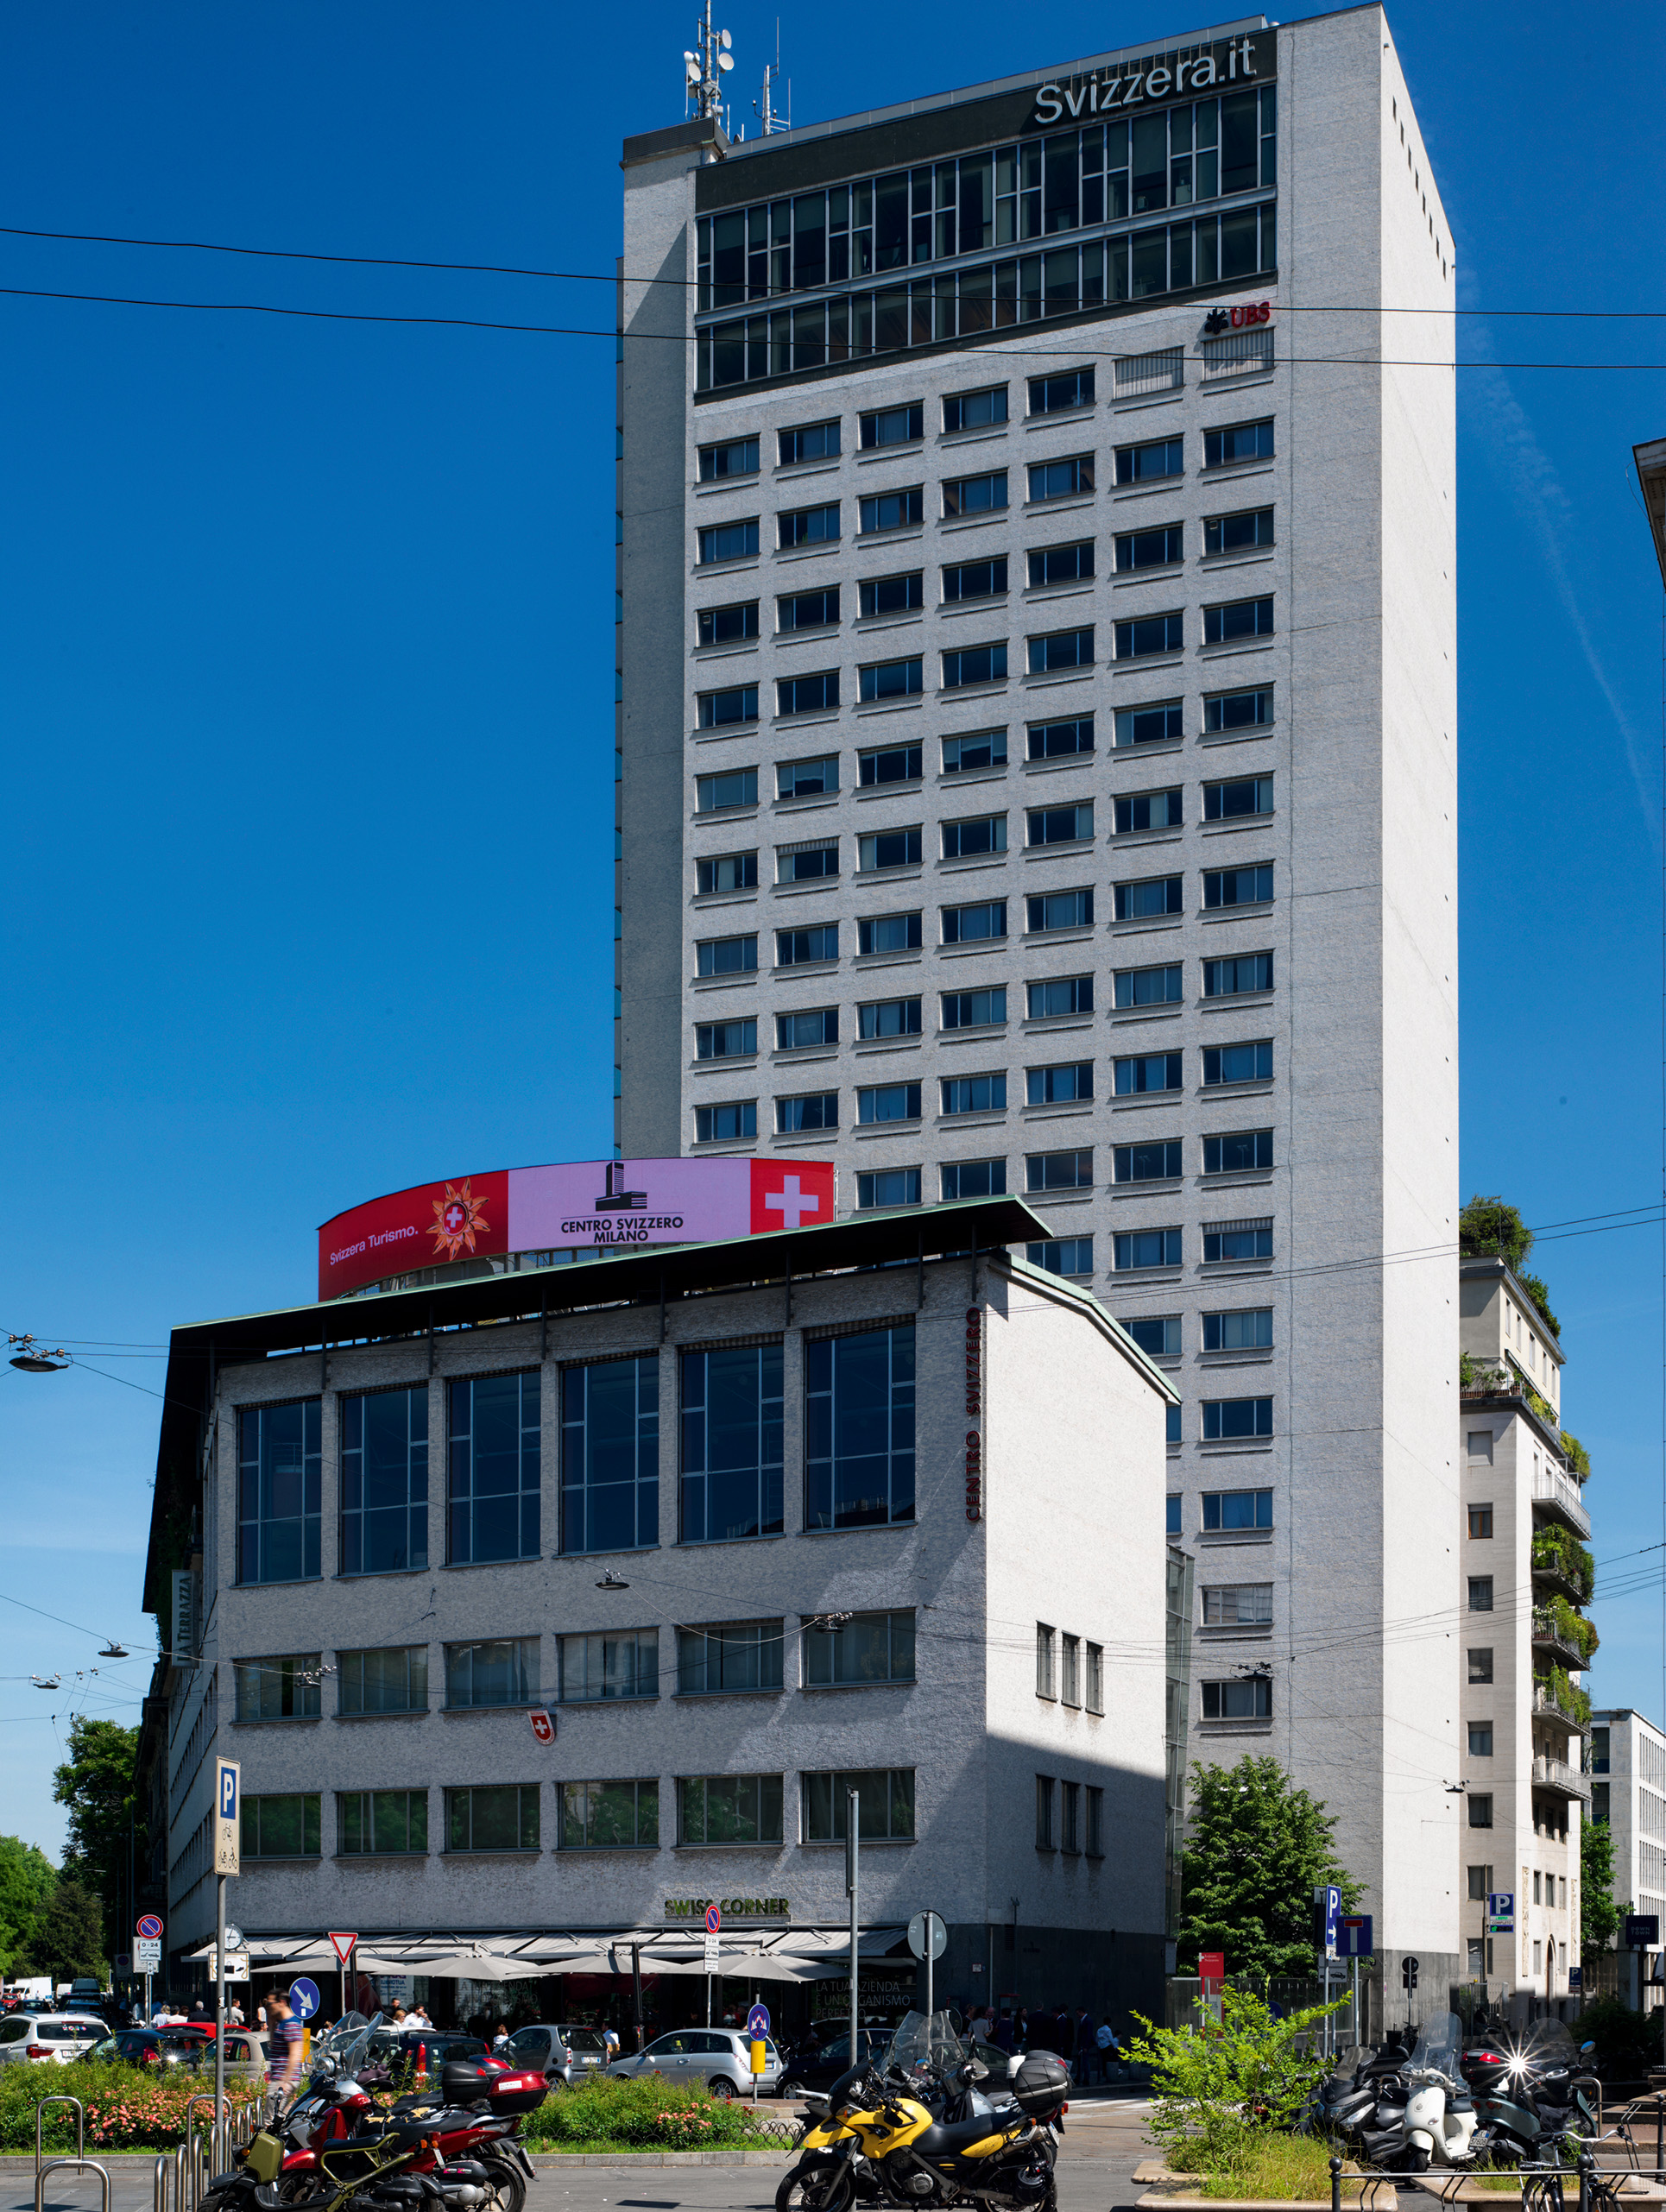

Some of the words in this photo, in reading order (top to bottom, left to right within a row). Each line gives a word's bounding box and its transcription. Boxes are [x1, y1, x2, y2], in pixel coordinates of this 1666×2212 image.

[1035, 39, 1257, 123] Svizzera.it
[1231, 302, 1271, 328] UBS
[561, 1219, 614, 1234] CENTRO
[616, 1216, 684, 1232] SVIZZERO
[593, 1229, 649, 1244] MILANO
[330, 1240, 366, 1267] Svizzera
[367, 1226, 419, 1252] Turismo.
[965, 1307, 981, 1415] SVIZZERO
[965, 1429, 981, 1522] CENTRO
[177, 1576, 192, 1642] TERRAZZA
[224, 1773, 233, 1812] P
[720, 1899, 789, 1915] CORNER
[1329, 1889, 1338, 1918] P
[1495, 1894, 1511, 1914] P
[1571, 1968, 1579, 1977] P
[816, 1981, 828, 1992] LA
[824, 1995, 840, 2006] UN
[842, 1995, 911, 2006] OGANISMO
